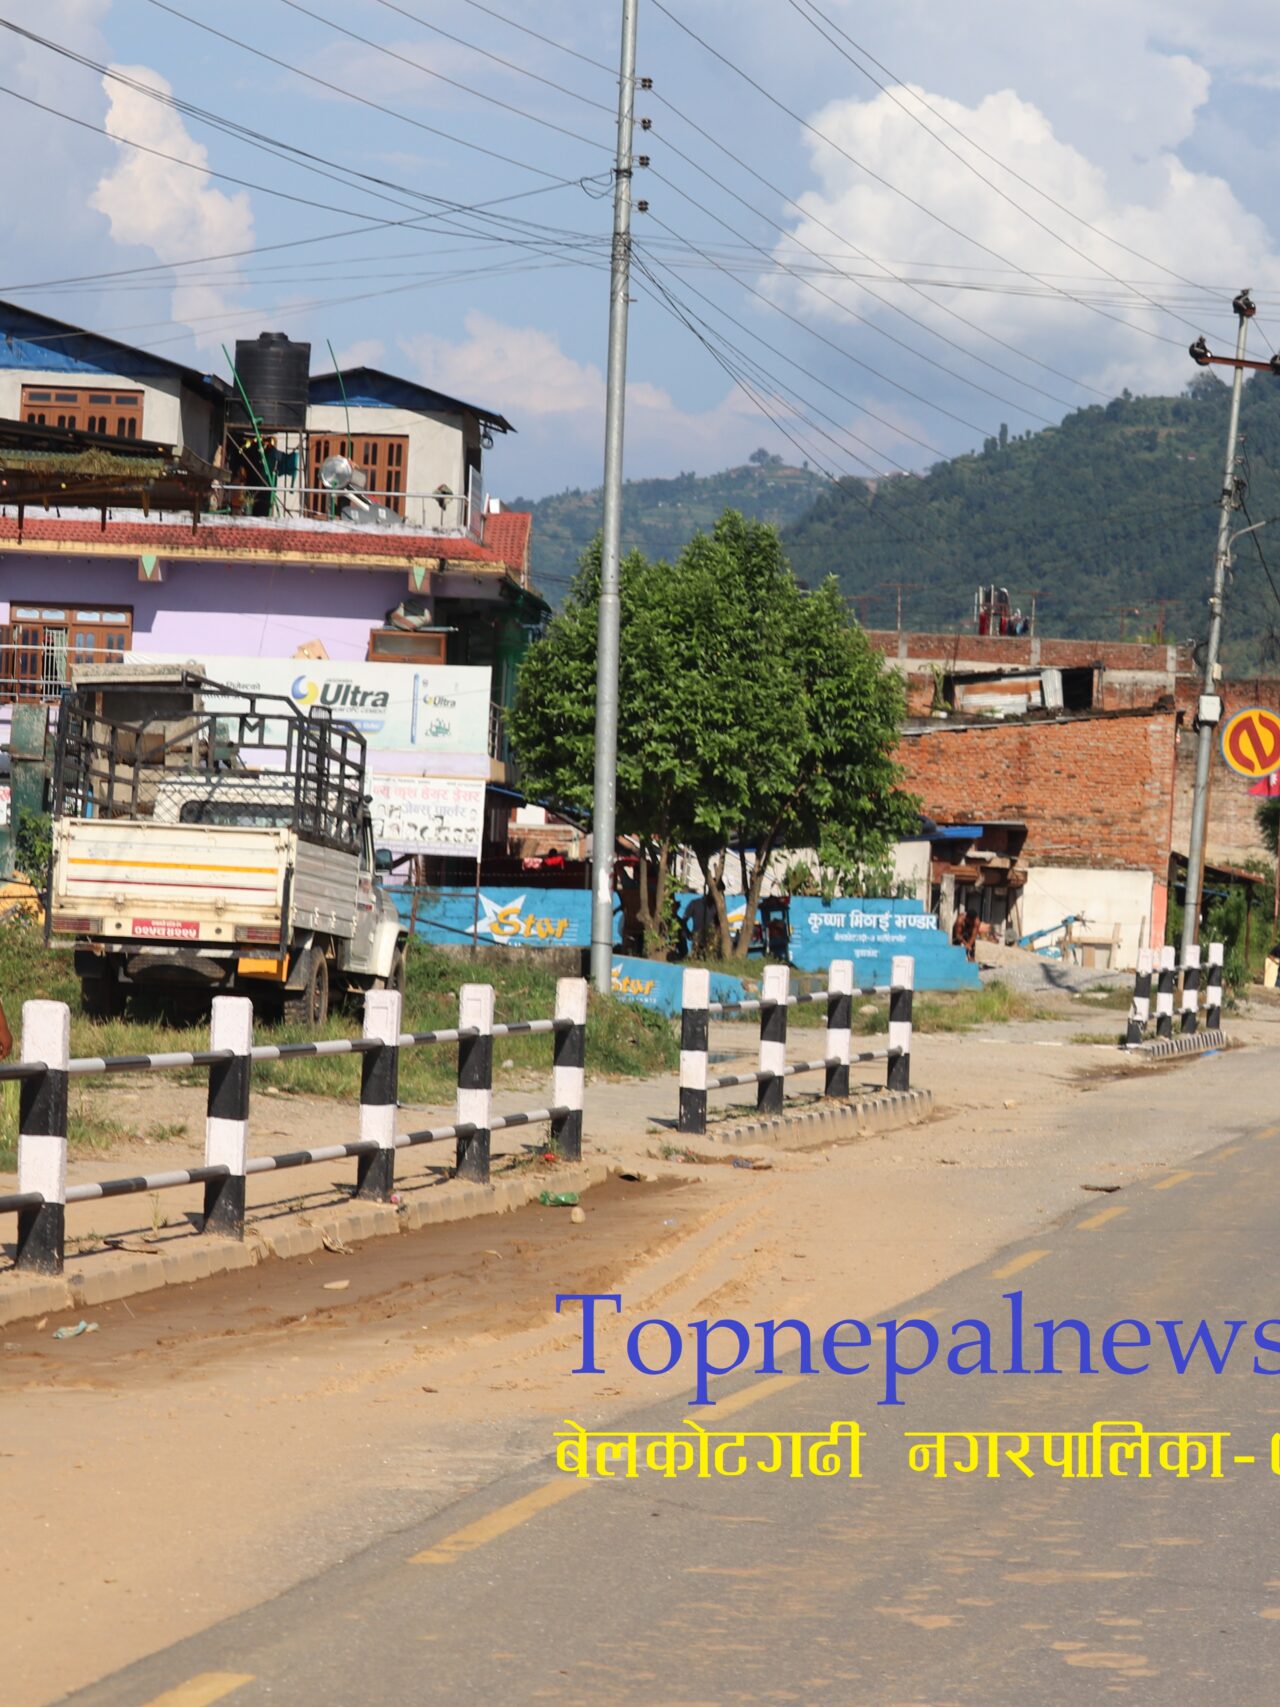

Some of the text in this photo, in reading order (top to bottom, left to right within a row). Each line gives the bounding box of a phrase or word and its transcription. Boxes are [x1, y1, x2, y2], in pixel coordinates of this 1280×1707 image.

[320, 683, 390, 708] Ultra
[489, 907, 570, 939] Star
[808, 912, 846, 933] कृष्णा
[894, 914, 938, 931] भण्डार
